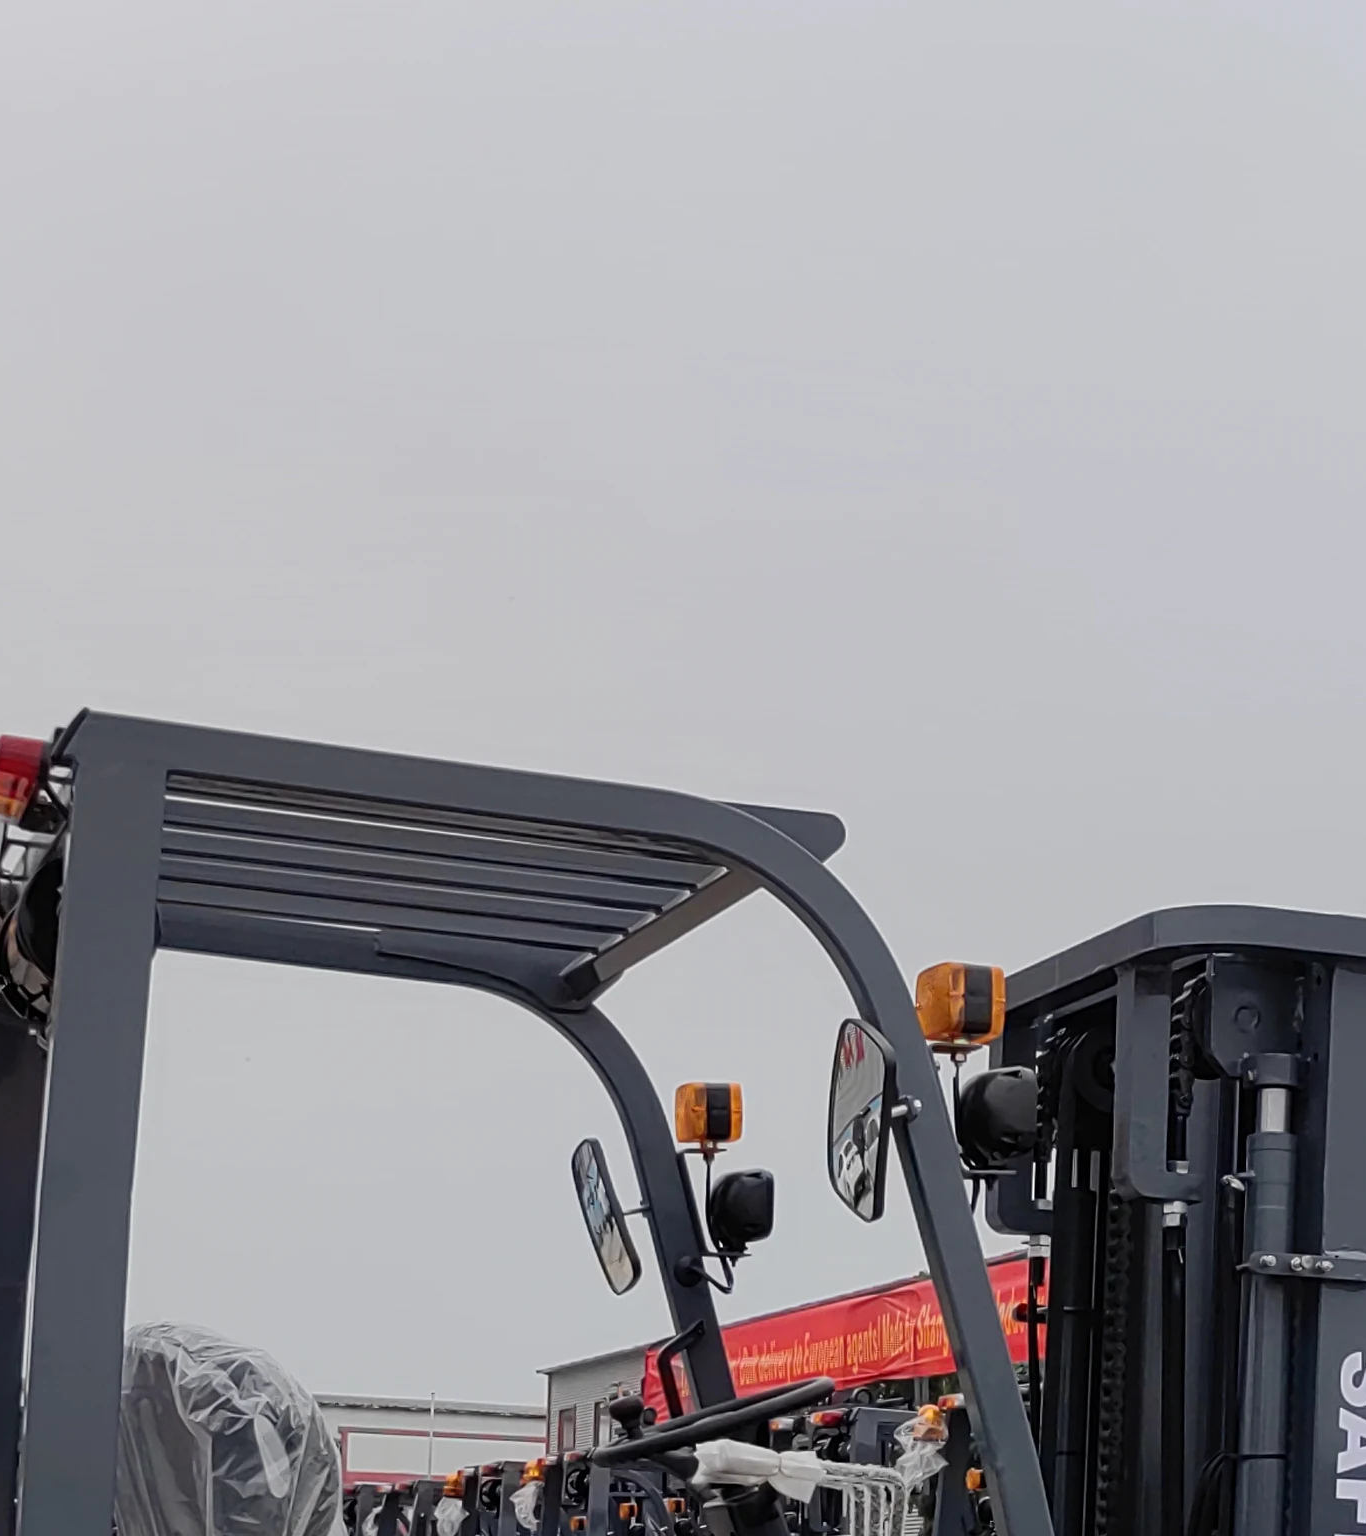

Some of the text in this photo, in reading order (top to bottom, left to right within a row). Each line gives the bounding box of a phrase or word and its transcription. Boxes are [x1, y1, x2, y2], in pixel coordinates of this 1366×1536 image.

[793, 1338, 803, 1377] to
[803, 1332, 845, 1375] European
[846, 1315, 881, 1374] agents!
